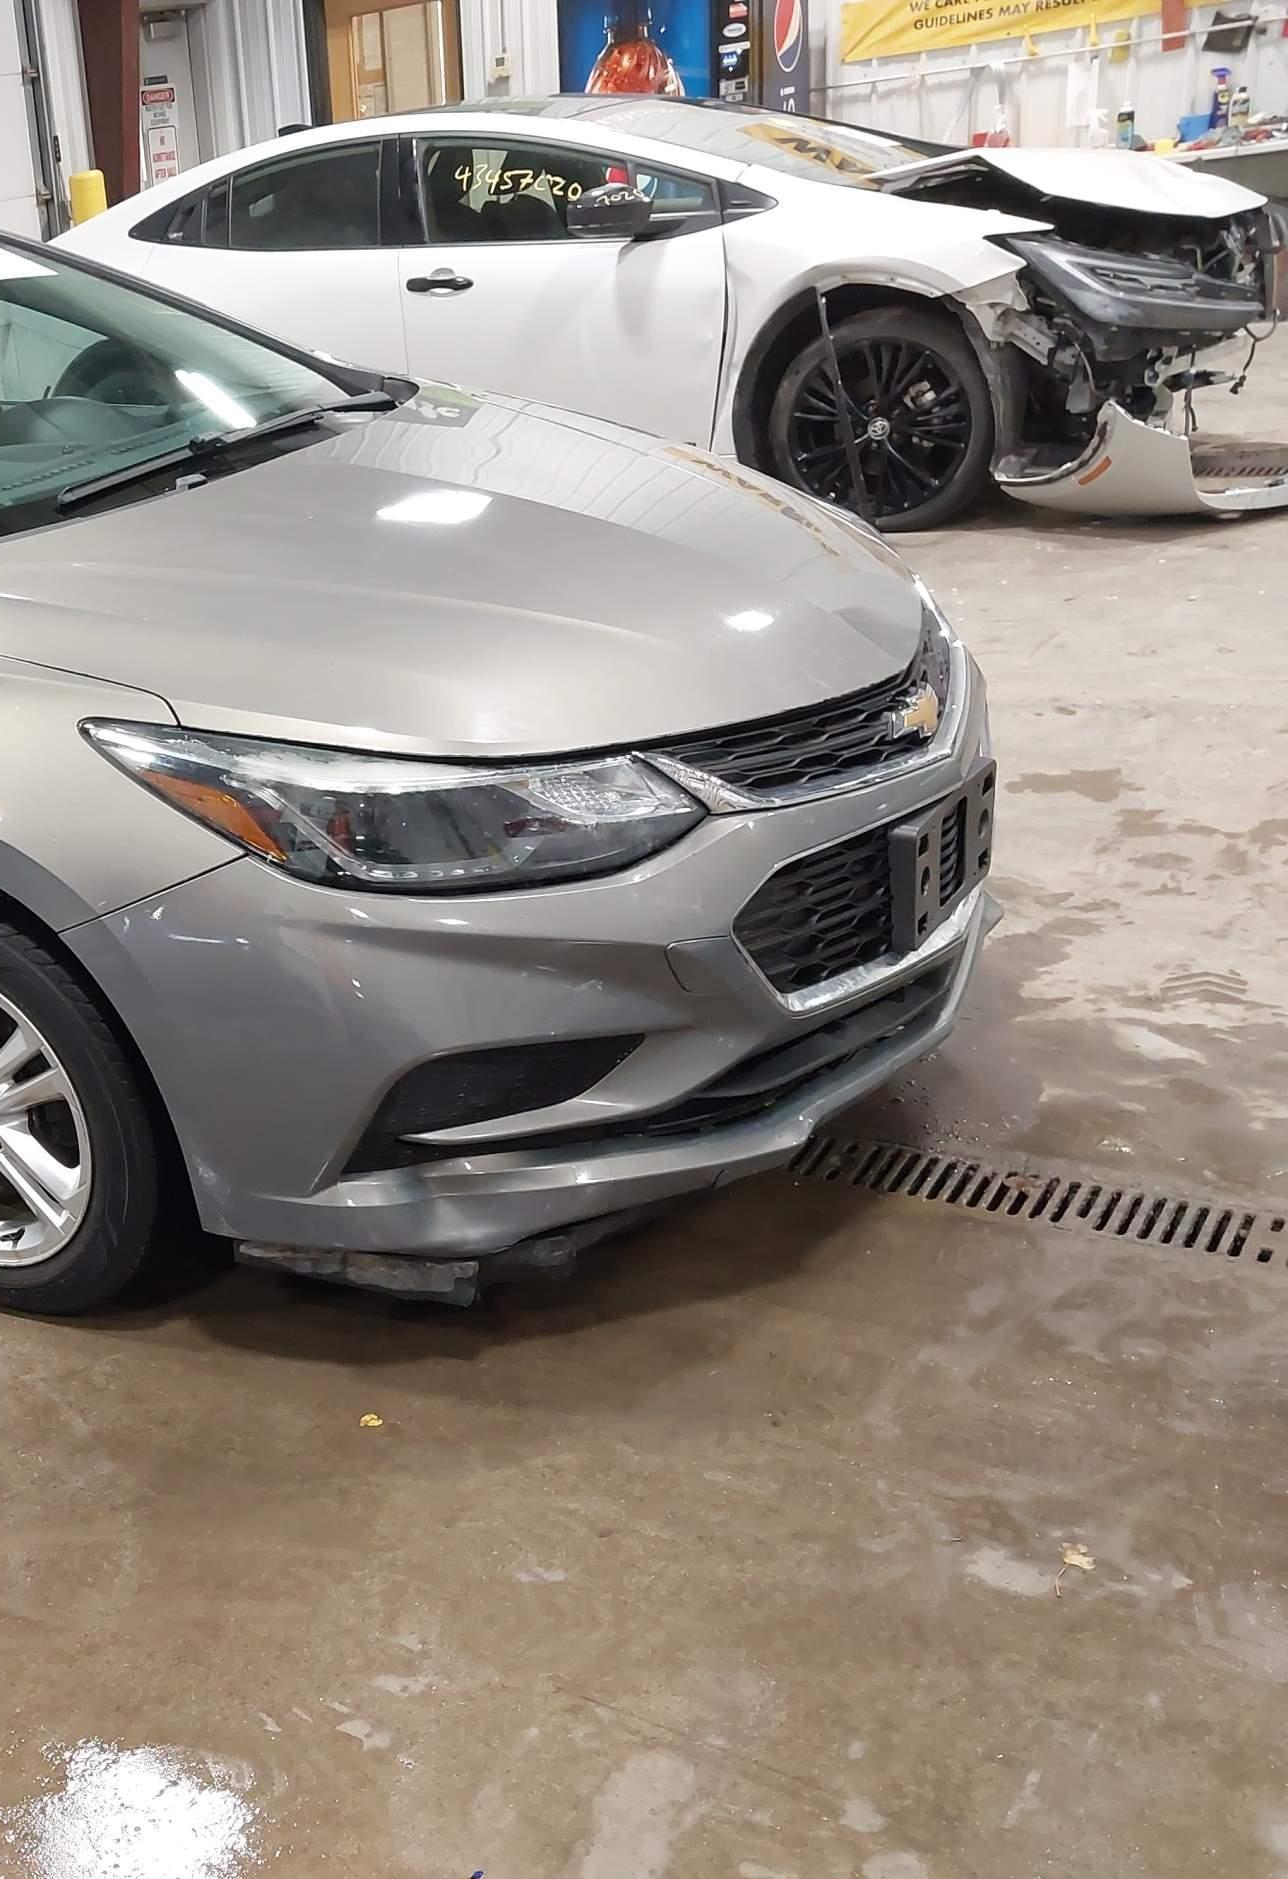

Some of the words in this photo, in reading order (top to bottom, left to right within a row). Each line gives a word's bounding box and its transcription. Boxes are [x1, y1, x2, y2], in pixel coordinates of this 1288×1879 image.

[909, 0, 930, 12] WE
[913, 8, 993, 30] GUIDELINES
[998, 2, 1030, 17] MAY
